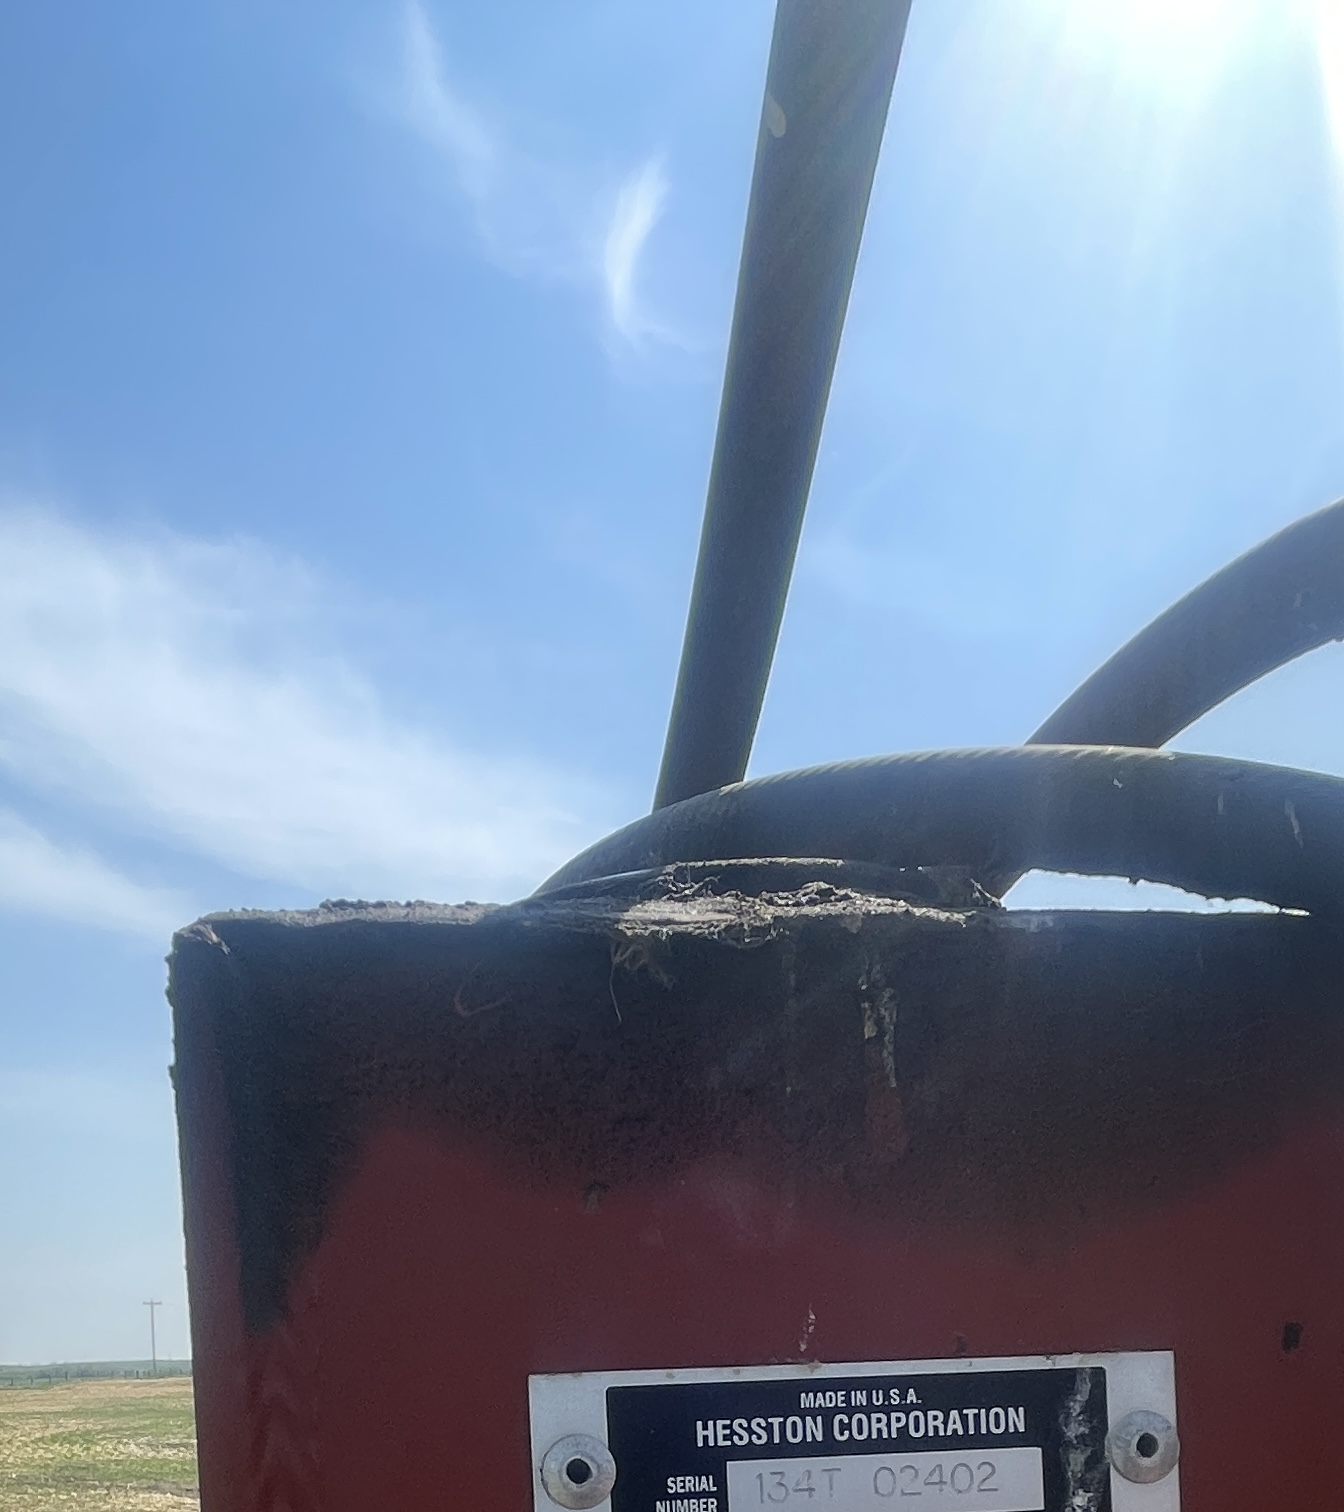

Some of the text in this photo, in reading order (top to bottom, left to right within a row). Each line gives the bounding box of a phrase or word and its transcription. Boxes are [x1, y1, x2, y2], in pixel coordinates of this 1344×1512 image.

[800, 1388, 923, 1409] MADE IN U.S.A.
[695, 1406, 1026, 1448] HESSTON CORPORATION
[666, 1474, 718, 1494] SERIAL
[755, 1461, 999, 1504] 134T 02402
